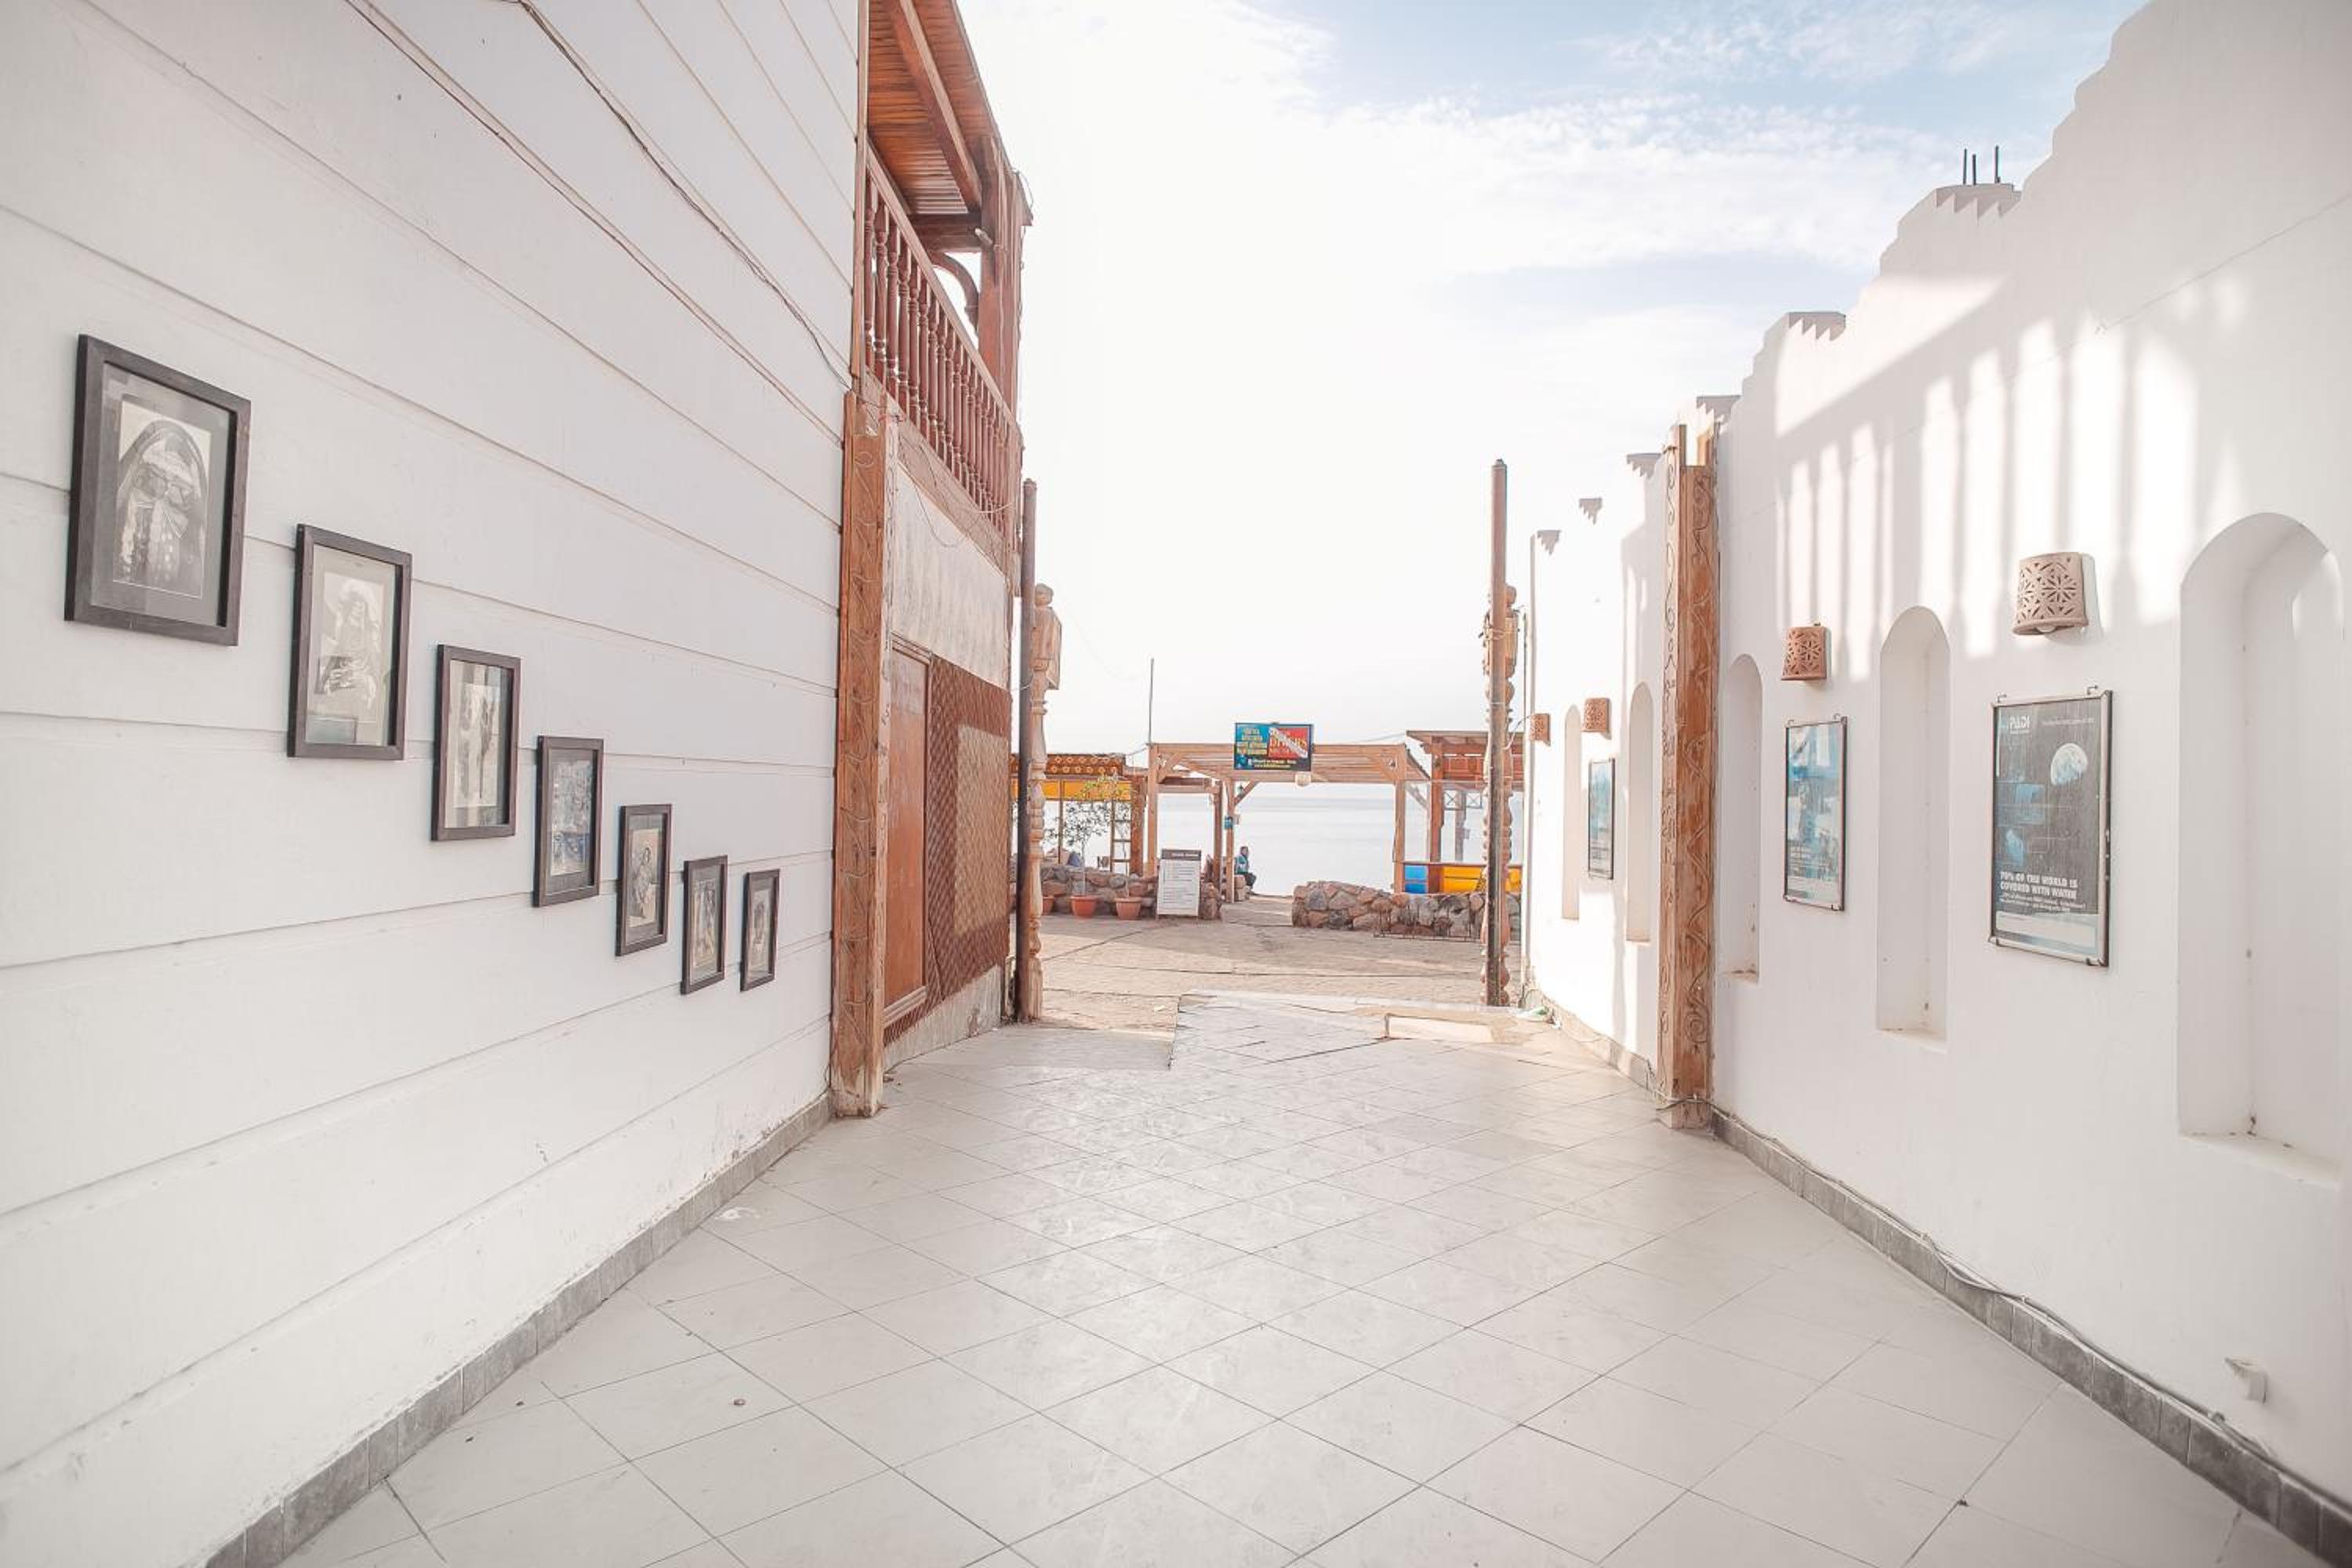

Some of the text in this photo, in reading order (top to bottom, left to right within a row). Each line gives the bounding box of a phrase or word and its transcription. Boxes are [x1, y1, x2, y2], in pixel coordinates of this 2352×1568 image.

[2009, 715, 2031, 728] PADI
[2027, 875, 2040, 884] THE
[2042, 877, 2067, 887] WORLD
[2071, 879, 2078, 888] IS
[2000, 881, 2077, 899] COVERED WITH WATER
